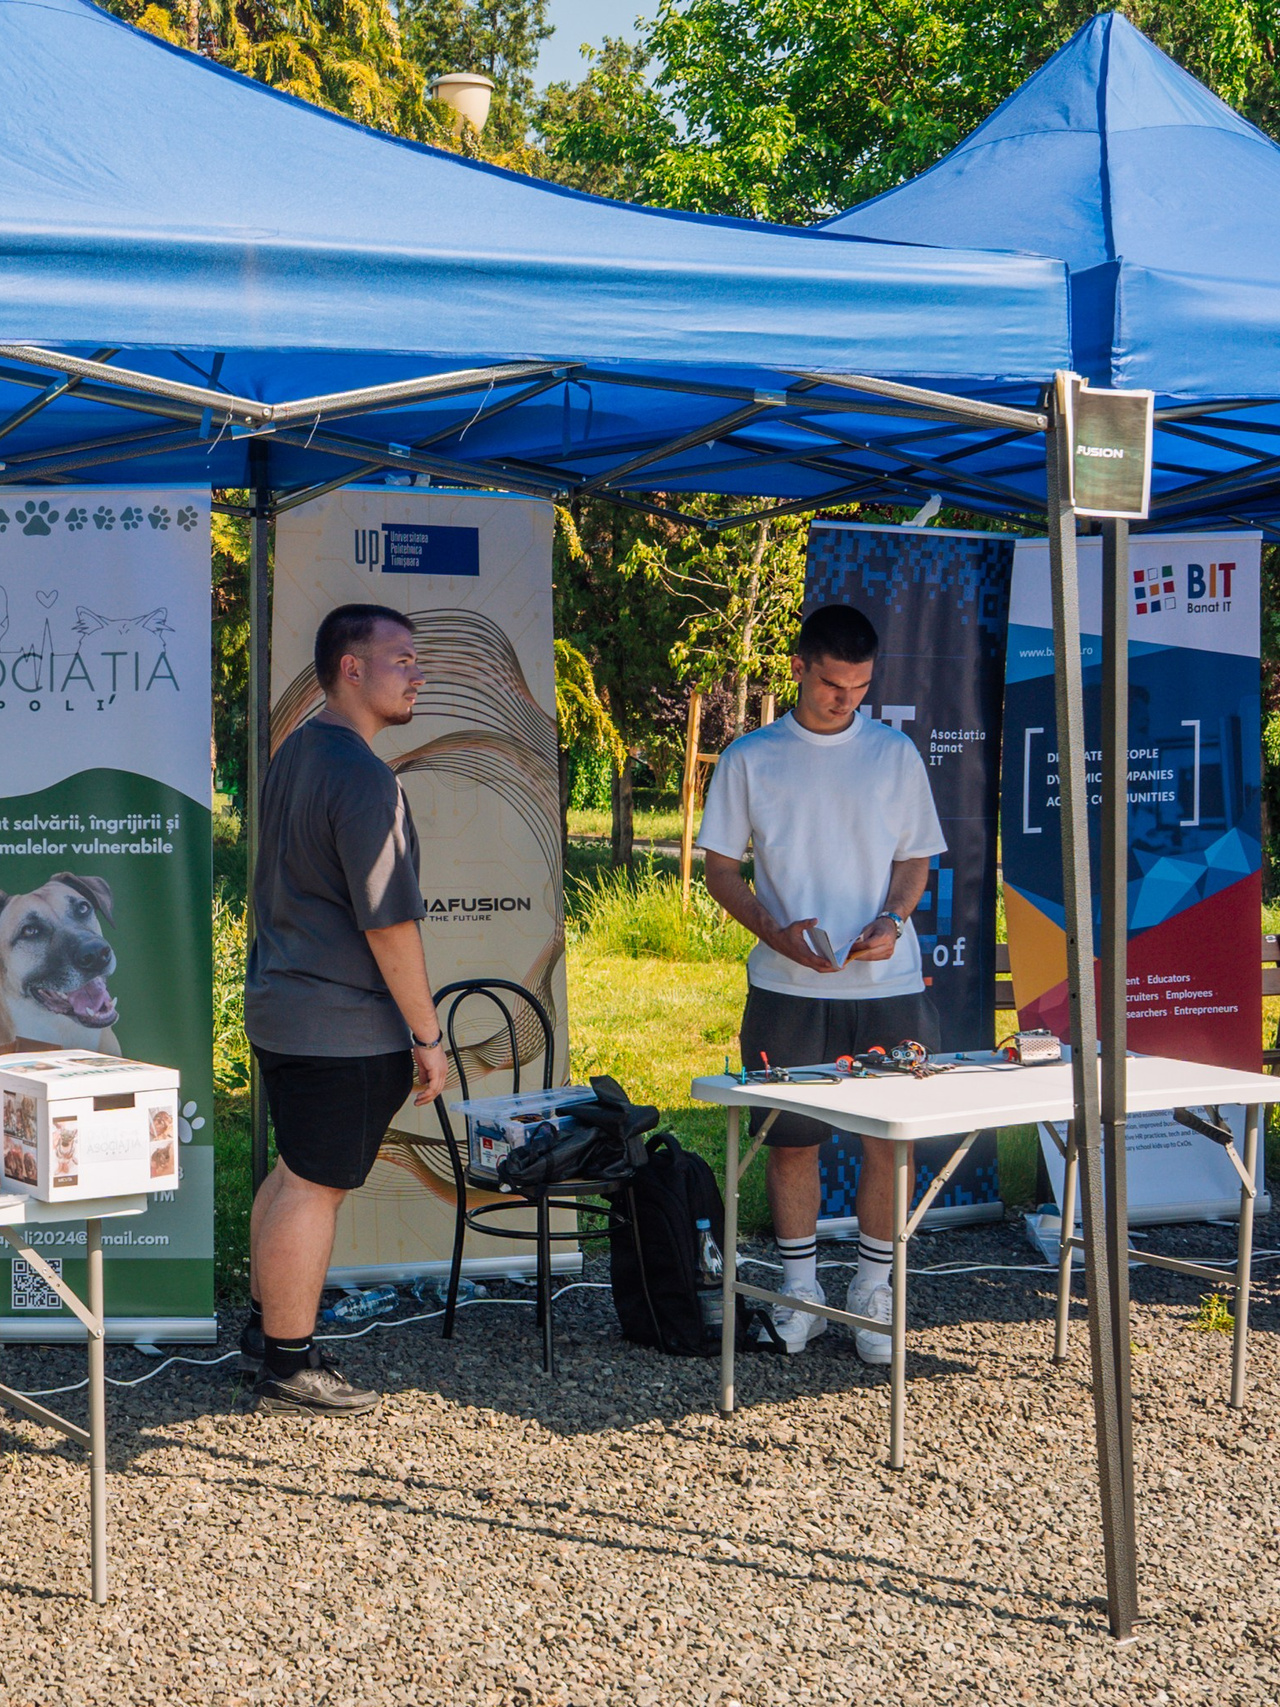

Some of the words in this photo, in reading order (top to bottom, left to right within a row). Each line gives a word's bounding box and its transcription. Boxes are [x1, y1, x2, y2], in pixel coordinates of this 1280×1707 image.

[390, 530, 429, 543] Universitatea
[390, 542, 423, 555] Politehnica
[1187, 562, 1236, 599] BIT
[1187, 601, 1219, 613] Banat
[1223, 601, 1231, 612] IT
[930, 729, 986, 742] Asociația
[929, 742, 963, 752] Banat
[929, 756, 943, 765] IT
[13, 815, 85, 833] salvării,
[89, 815, 161, 835] îngrijirii
[166, 814, 180, 835] și
[71, 837, 173, 854] vulnerabile
[933, 936, 966, 967] of
[1147, 974, 1191, 984] Educators
[1166, 989, 1213, 1000] Employees
[1174, 1005, 1239, 1016] Entrepreneurs
